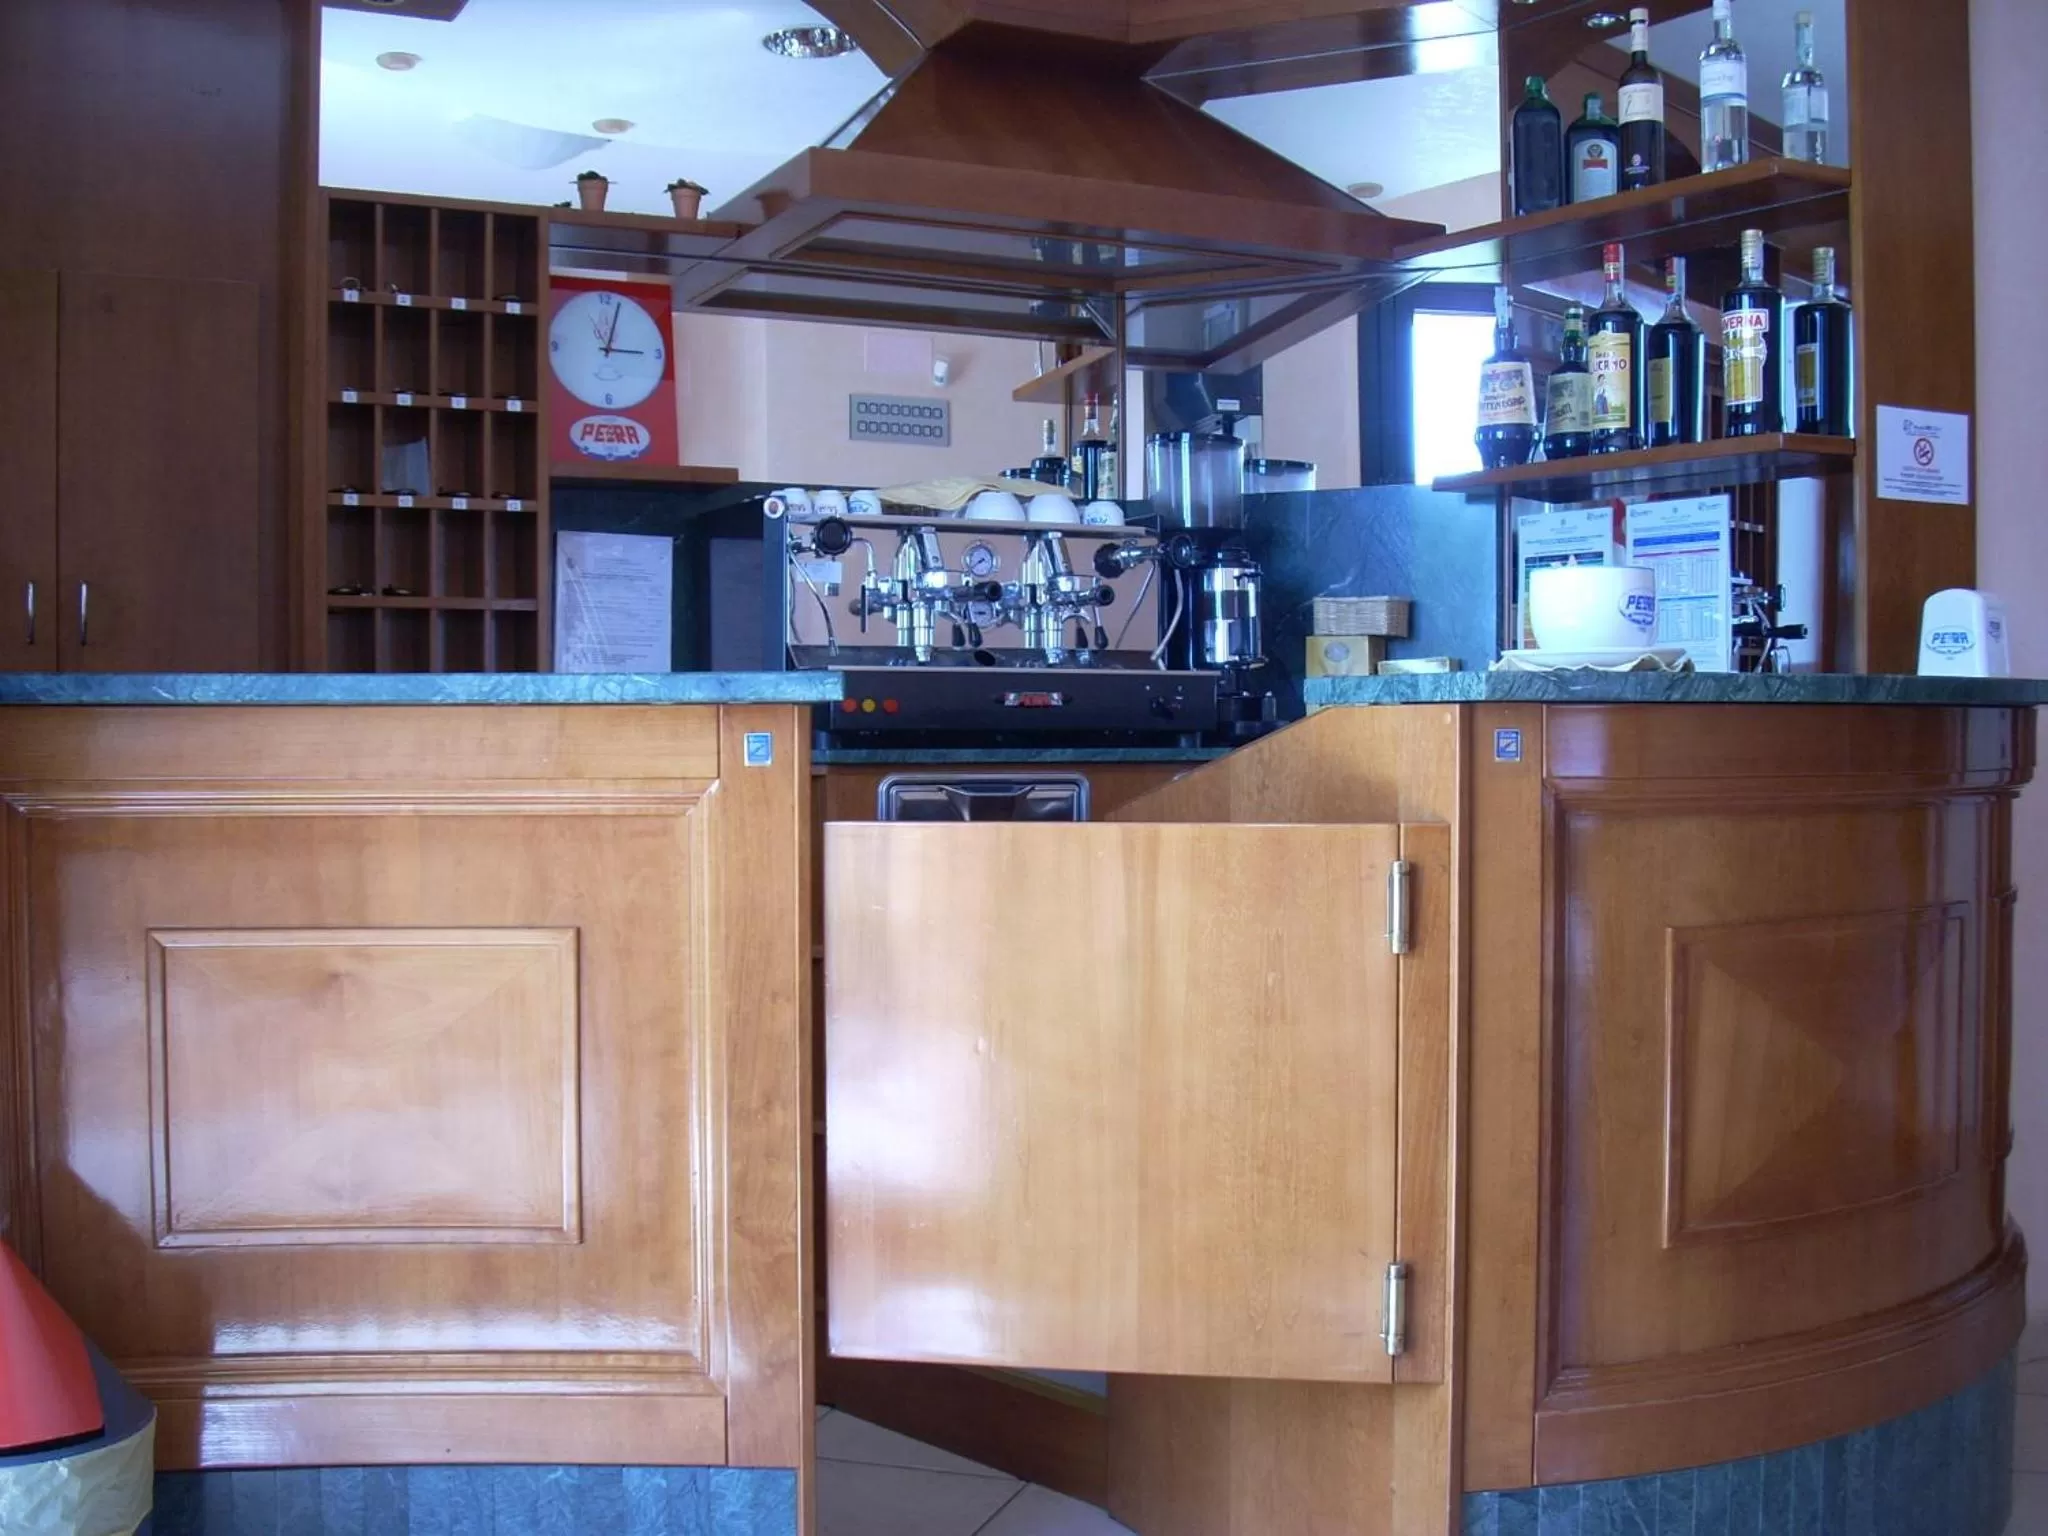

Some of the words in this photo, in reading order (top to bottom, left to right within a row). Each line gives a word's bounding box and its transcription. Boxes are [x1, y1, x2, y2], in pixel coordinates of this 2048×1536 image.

[599, 293, 612, 305] 12
[1723, 314, 1763, 330] VERNA
[551, 340, 560, 352] 9
[655, 348, 662, 359] 3
[605, 393, 613, 405] 6
